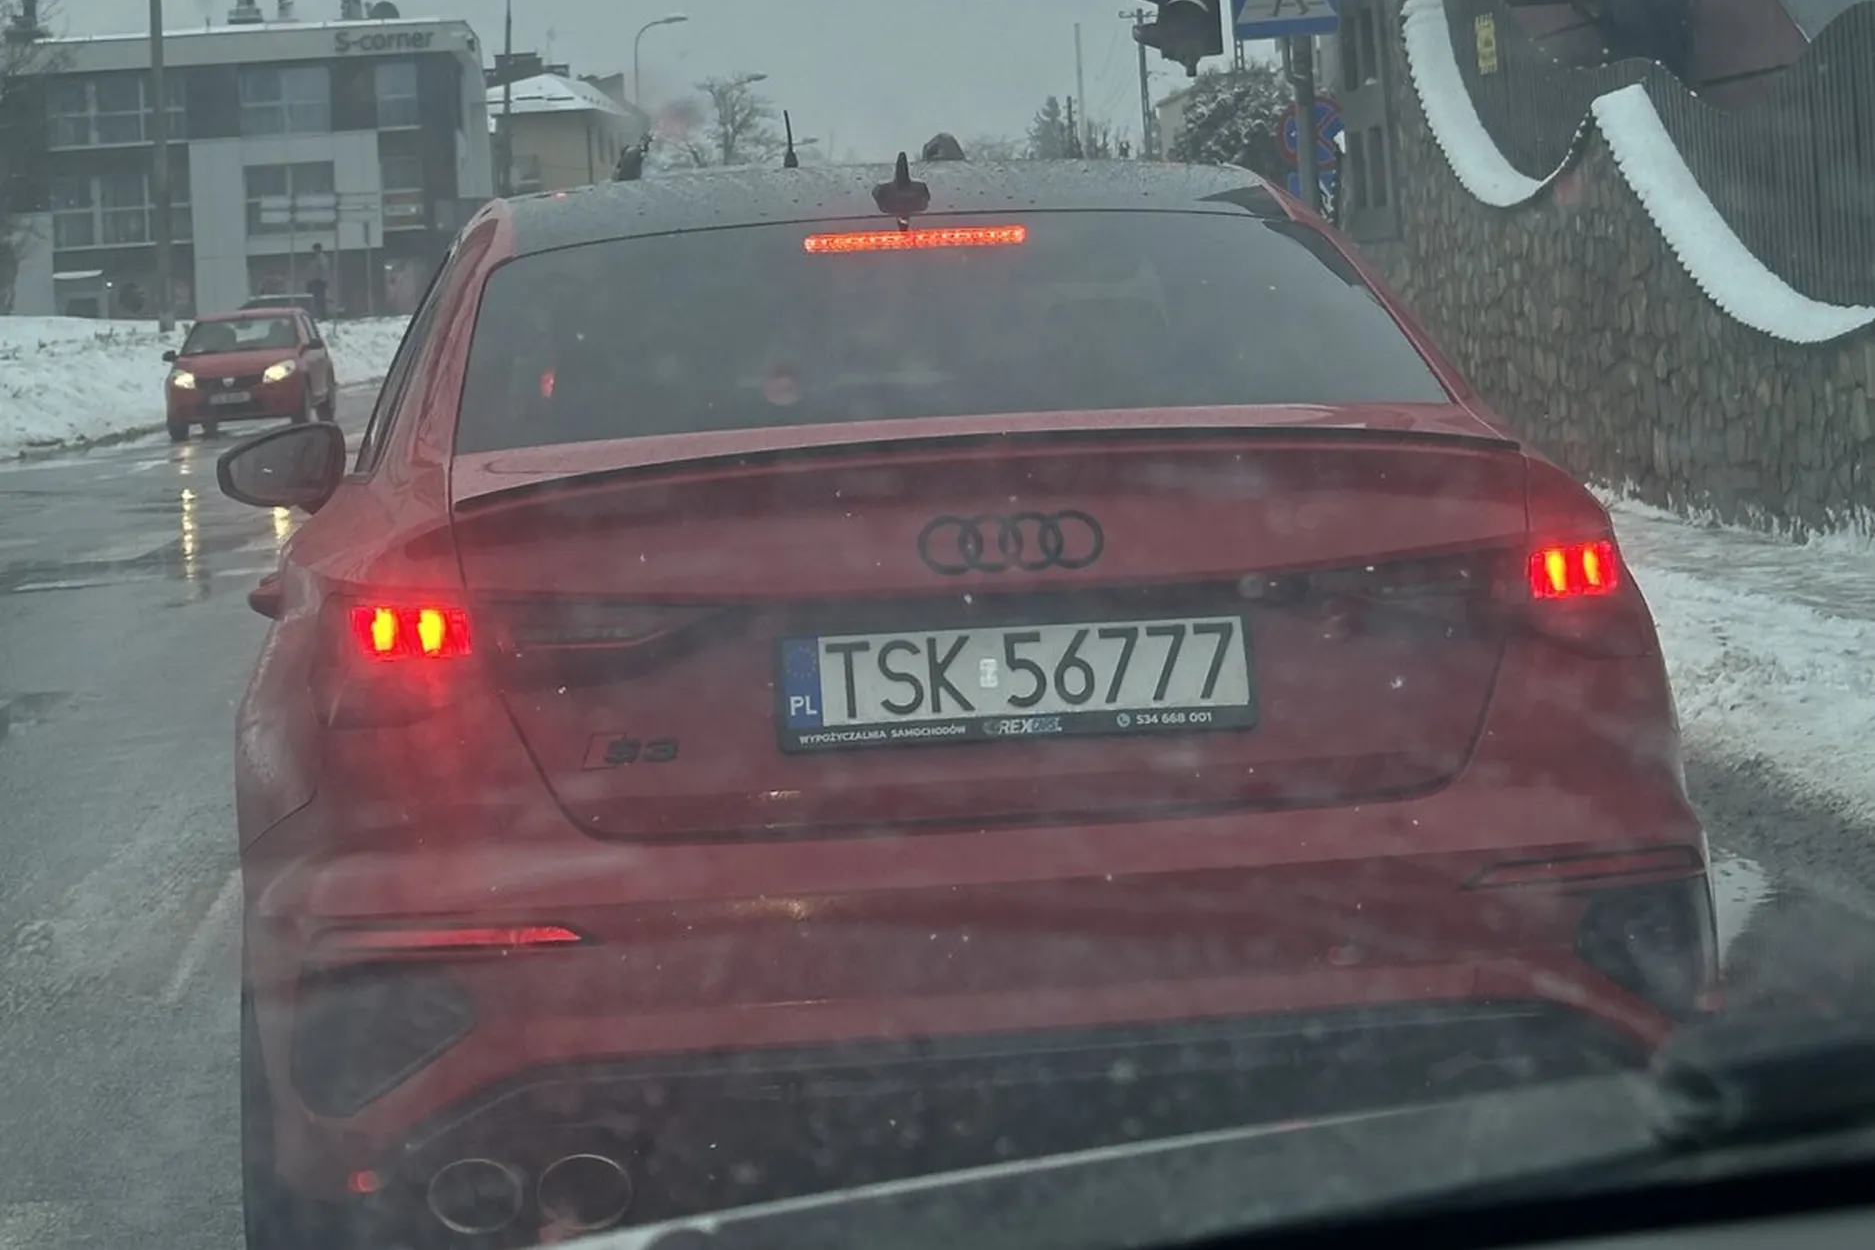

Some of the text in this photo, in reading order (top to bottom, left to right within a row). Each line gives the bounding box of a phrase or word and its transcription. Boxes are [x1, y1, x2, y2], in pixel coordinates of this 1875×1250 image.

[825, 623, 1234, 719] TSK 56777
[790, 694, 818, 717] PL
